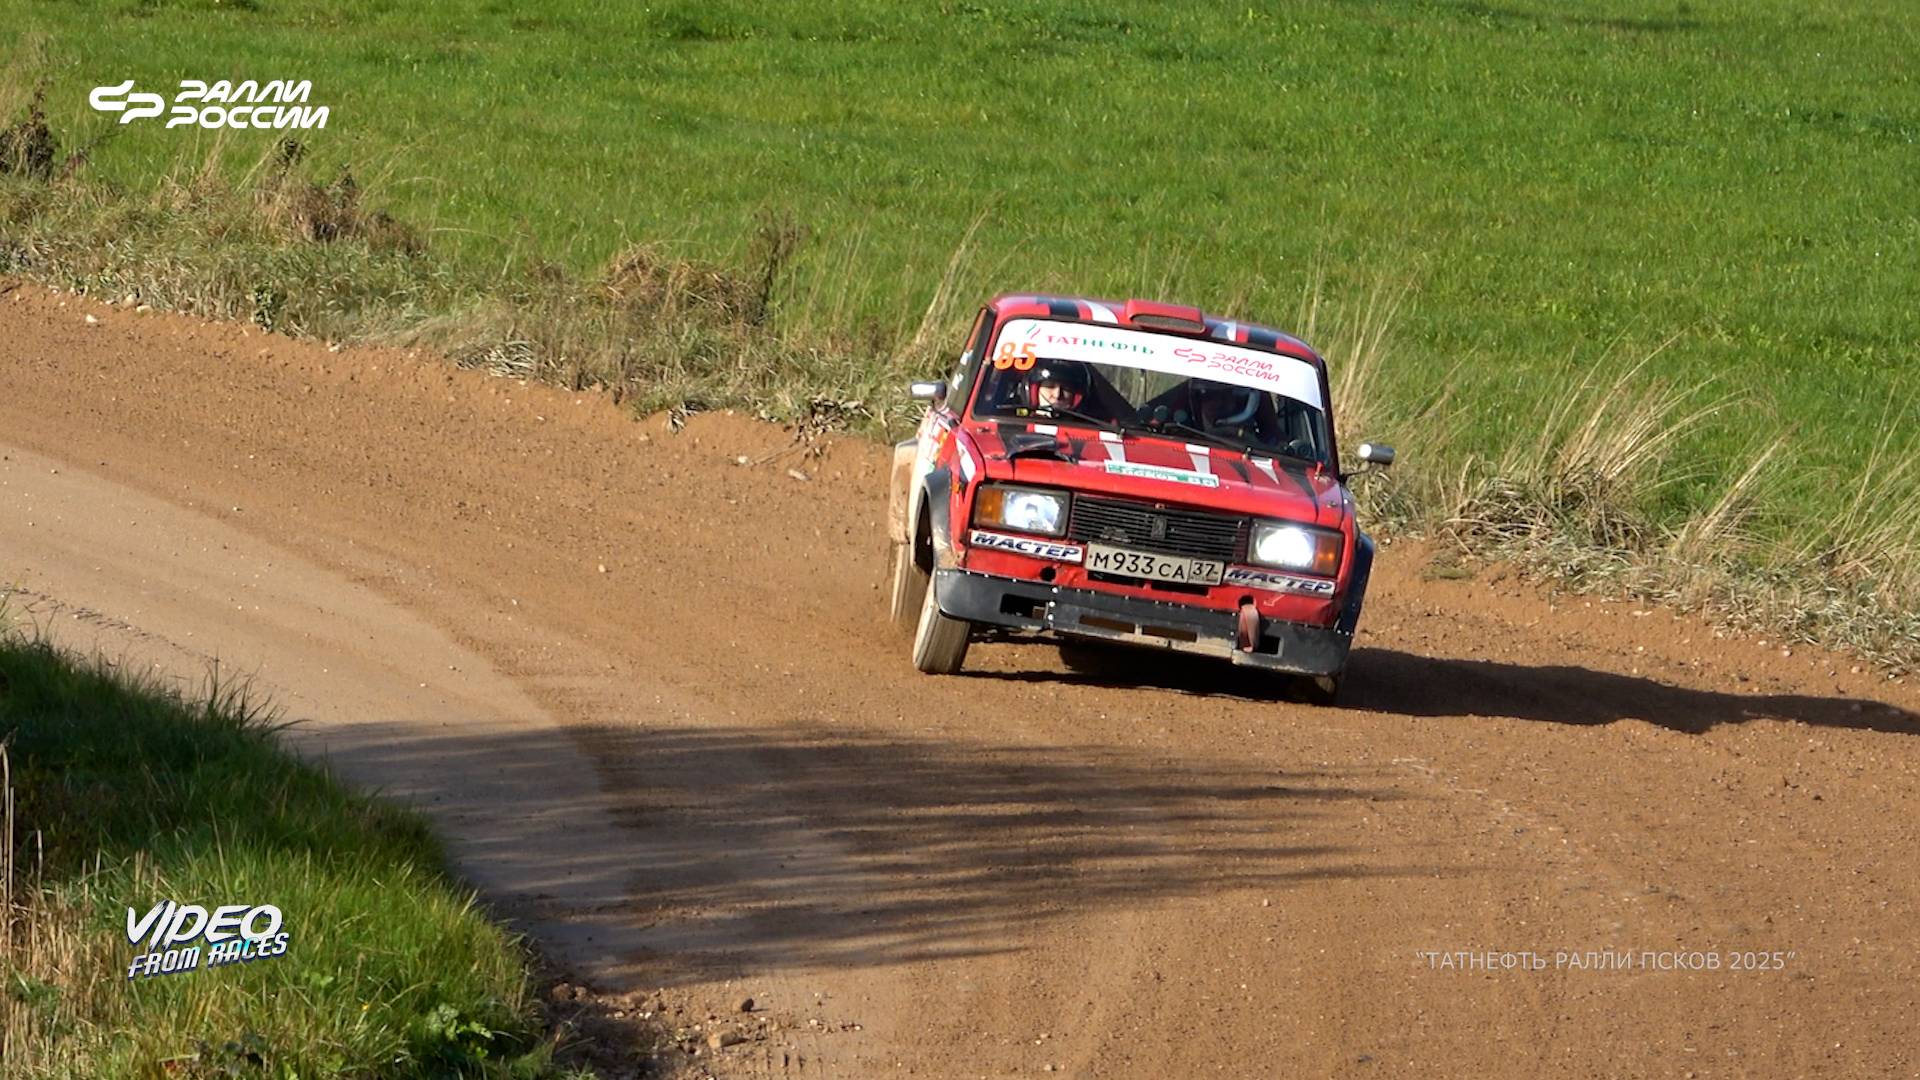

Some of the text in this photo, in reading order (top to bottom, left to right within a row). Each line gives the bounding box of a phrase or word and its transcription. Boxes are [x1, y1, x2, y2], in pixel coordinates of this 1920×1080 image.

[1046, 335, 1155, 355] ТАТНЕФТЬ
[994, 342, 1037, 371] 85
[1212, 352, 1274, 371] РАЛЛИ
[1207, 360, 1281, 382] РОССИИ
[973, 532, 1081, 560] МАСТЕР
[1193, 562, 1216, 578] 37
[1227, 567, 1334, 594] МАСТЕР
